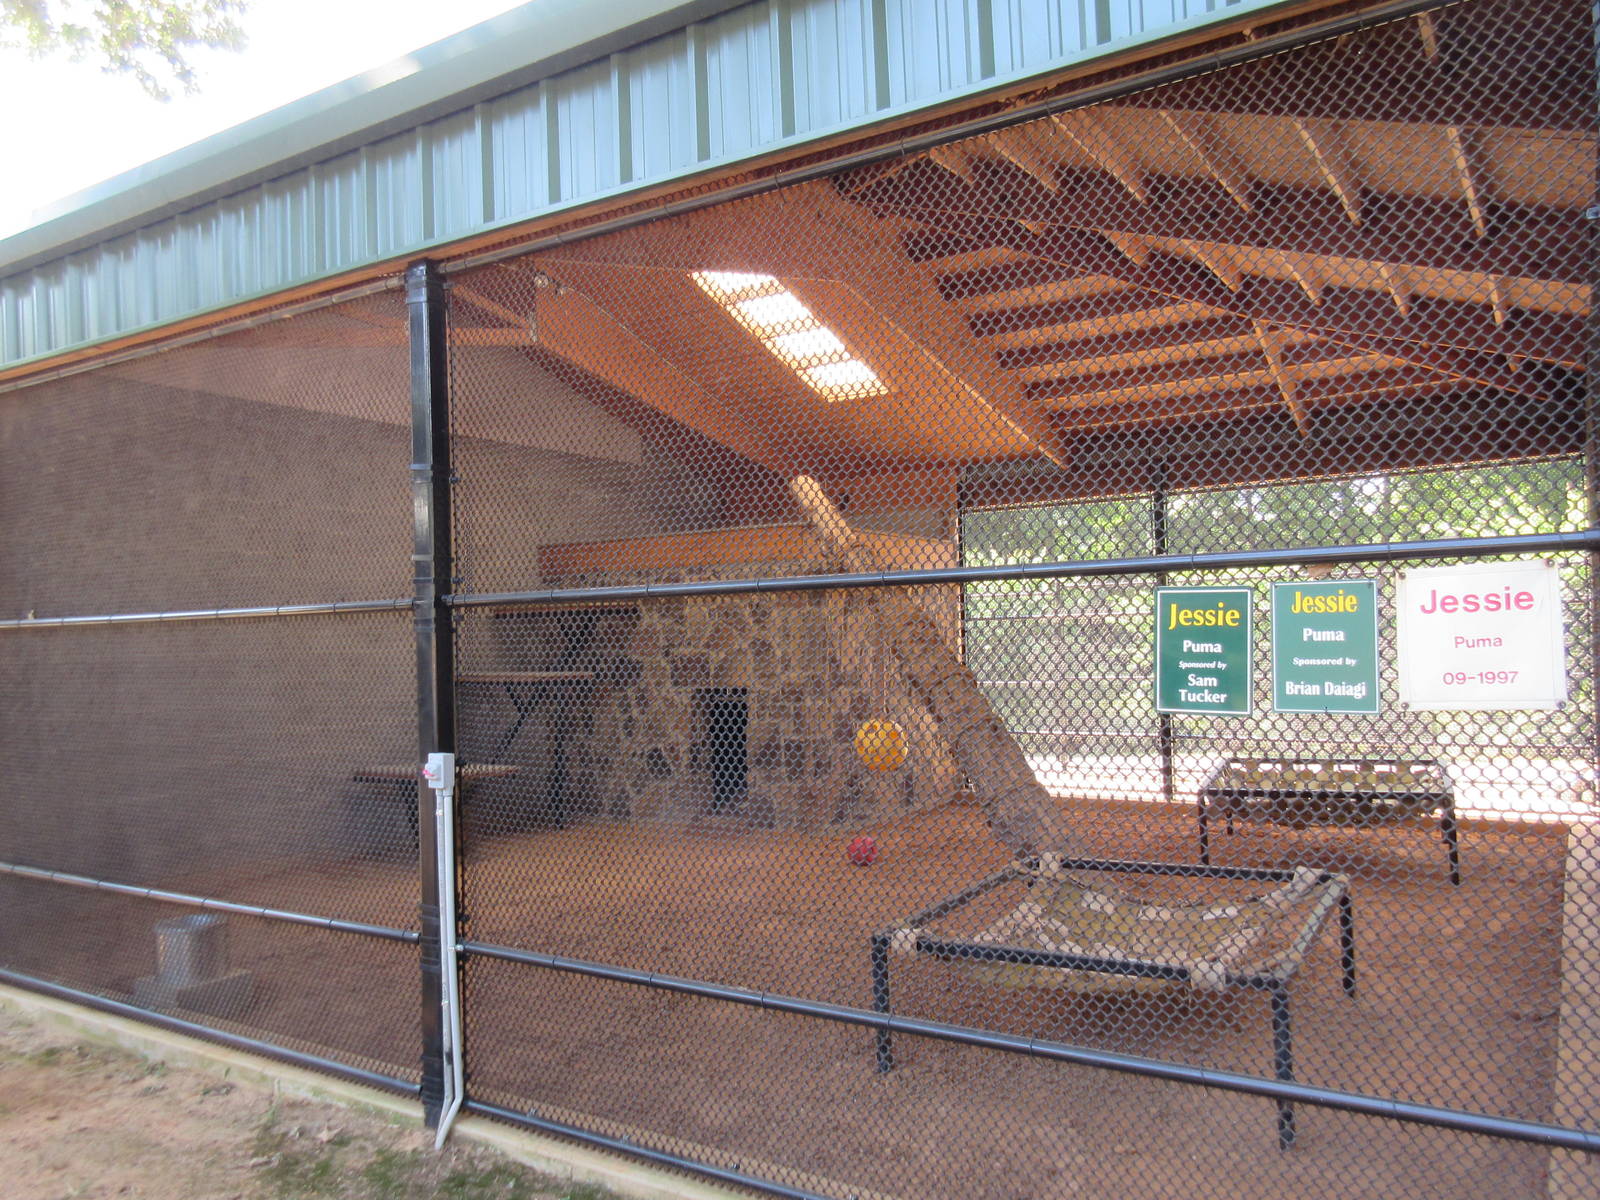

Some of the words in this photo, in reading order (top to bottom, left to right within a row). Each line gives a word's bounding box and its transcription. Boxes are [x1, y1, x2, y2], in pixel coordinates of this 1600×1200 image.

[1291, 589, 1358, 614] Jessie
[1419, 586, 1535, 614] Jessie
[1168, 601, 1240, 630] Jessie
[1302, 627, 1345, 642] Puma
[1454, 635, 1503, 648] Puma
[1182, 639, 1222, 653] Puma
[1178, 660, 1216, 670] Sponsored
[1217, 661, 1227, 670] by
[1292, 656, 1343, 667] Sponsored
[1345, 657, 1357, 667] by
[1187, 673, 1218, 687] Sam
[1442, 670, 1519, 685] 09-1997
[1178, 688, 1227, 703] Tucker
[1285, 681, 1320, 696] Brian
[1324, 681, 1366, 699] Daiagi
